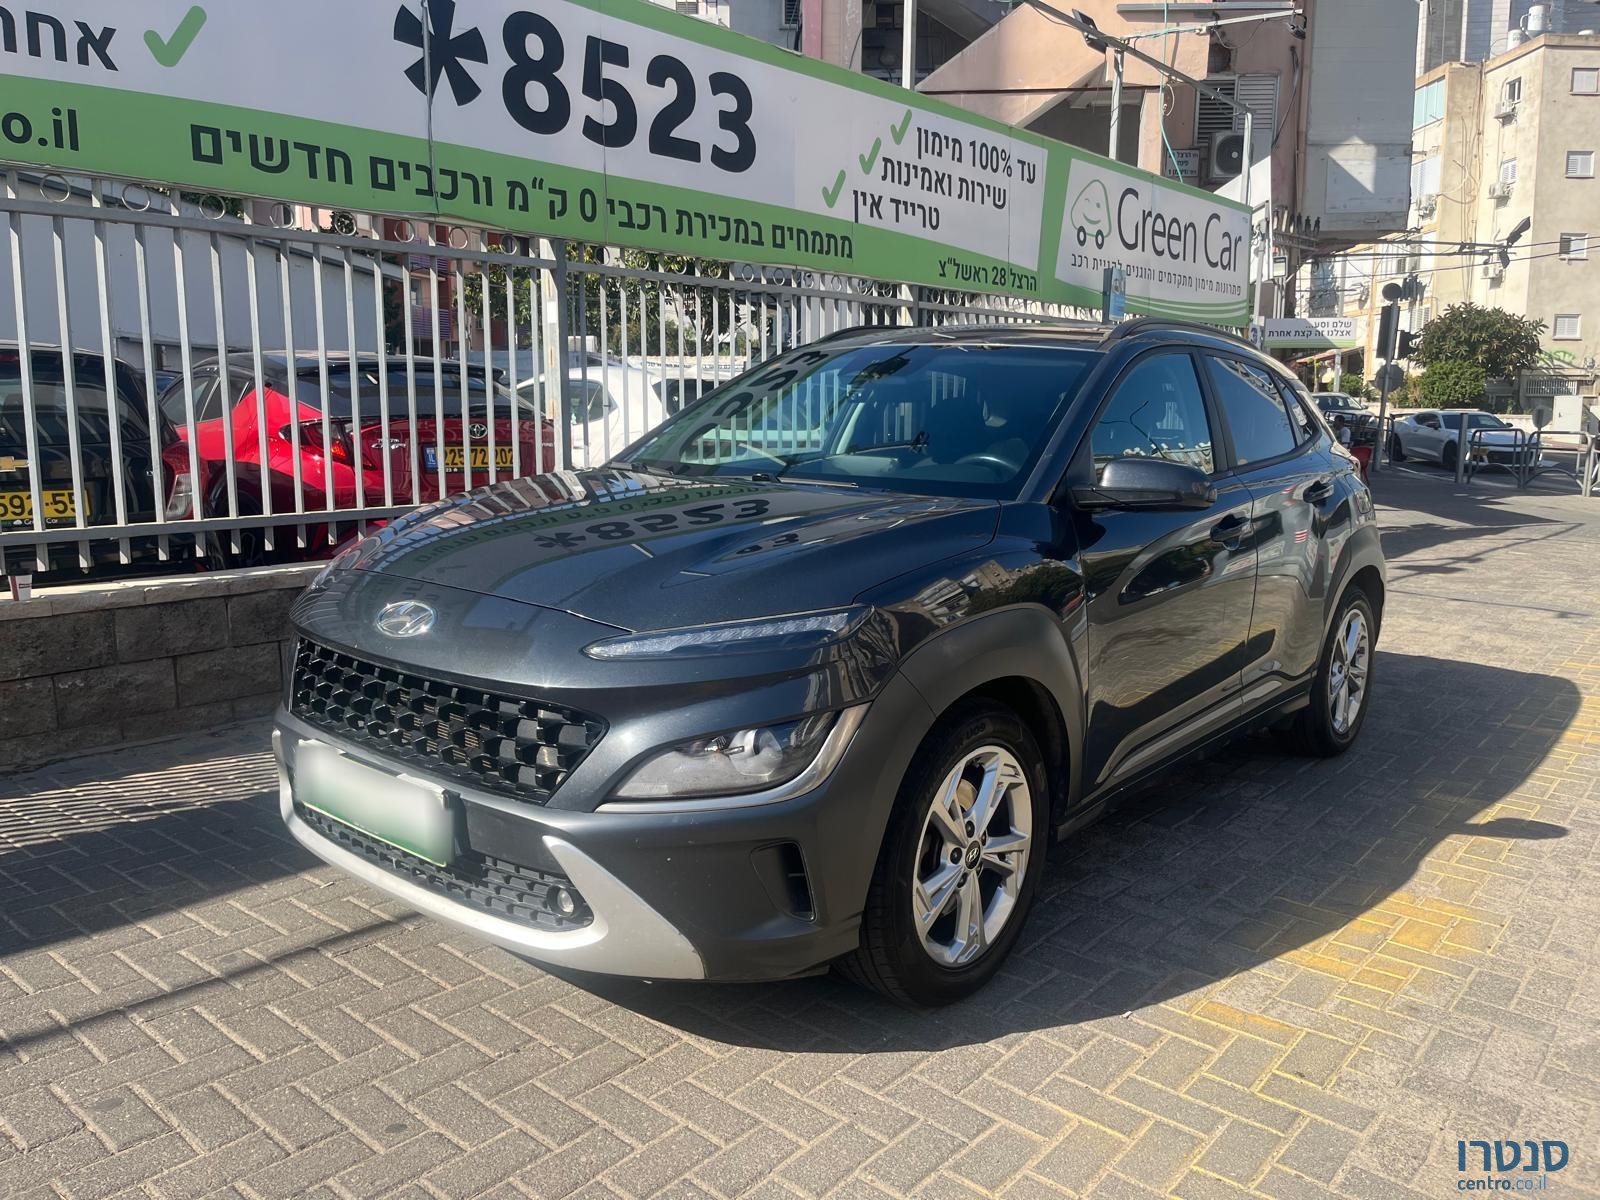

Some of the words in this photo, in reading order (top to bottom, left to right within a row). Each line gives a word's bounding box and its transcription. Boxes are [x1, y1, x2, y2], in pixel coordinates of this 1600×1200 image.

[190, 124, 354, 186] חדשים
[916, 127, 963, 164] מימון
[969, 140, 1013, 178] 100%
[370, 156, 494, 207] ורכבים
[881, 157, 952, 197] ואמינות
[1017, 159, 1036, 185] עד
[579, 188, 598, 223] 0
[852, 190, 884, 224] אין
[957, 177, 1007, 210] שירות
[605, 198, 667, 234] רכבי
[675, 208, 765, 247] במכירת
[889, 198, 941, 231] טרייד
[1117, 187, 1197, 264] Green
[1204, 212, 1242, 273] Car
[771, 224, 853, 259] מתמחים
[991, 265, 1007, 287] 28
[1071, 253, 1089, 269] רכב
[1009, 267, 1038, 292] הרצל
[1195, 278, 1214, 292] מימון
[1268, 329, 1292, 338] אחרת
[1294, 329, 1313, 340] קצת
[1327, 329, 1352, 337] אצלנו
[1332, 320, 1352, 329] שלם
